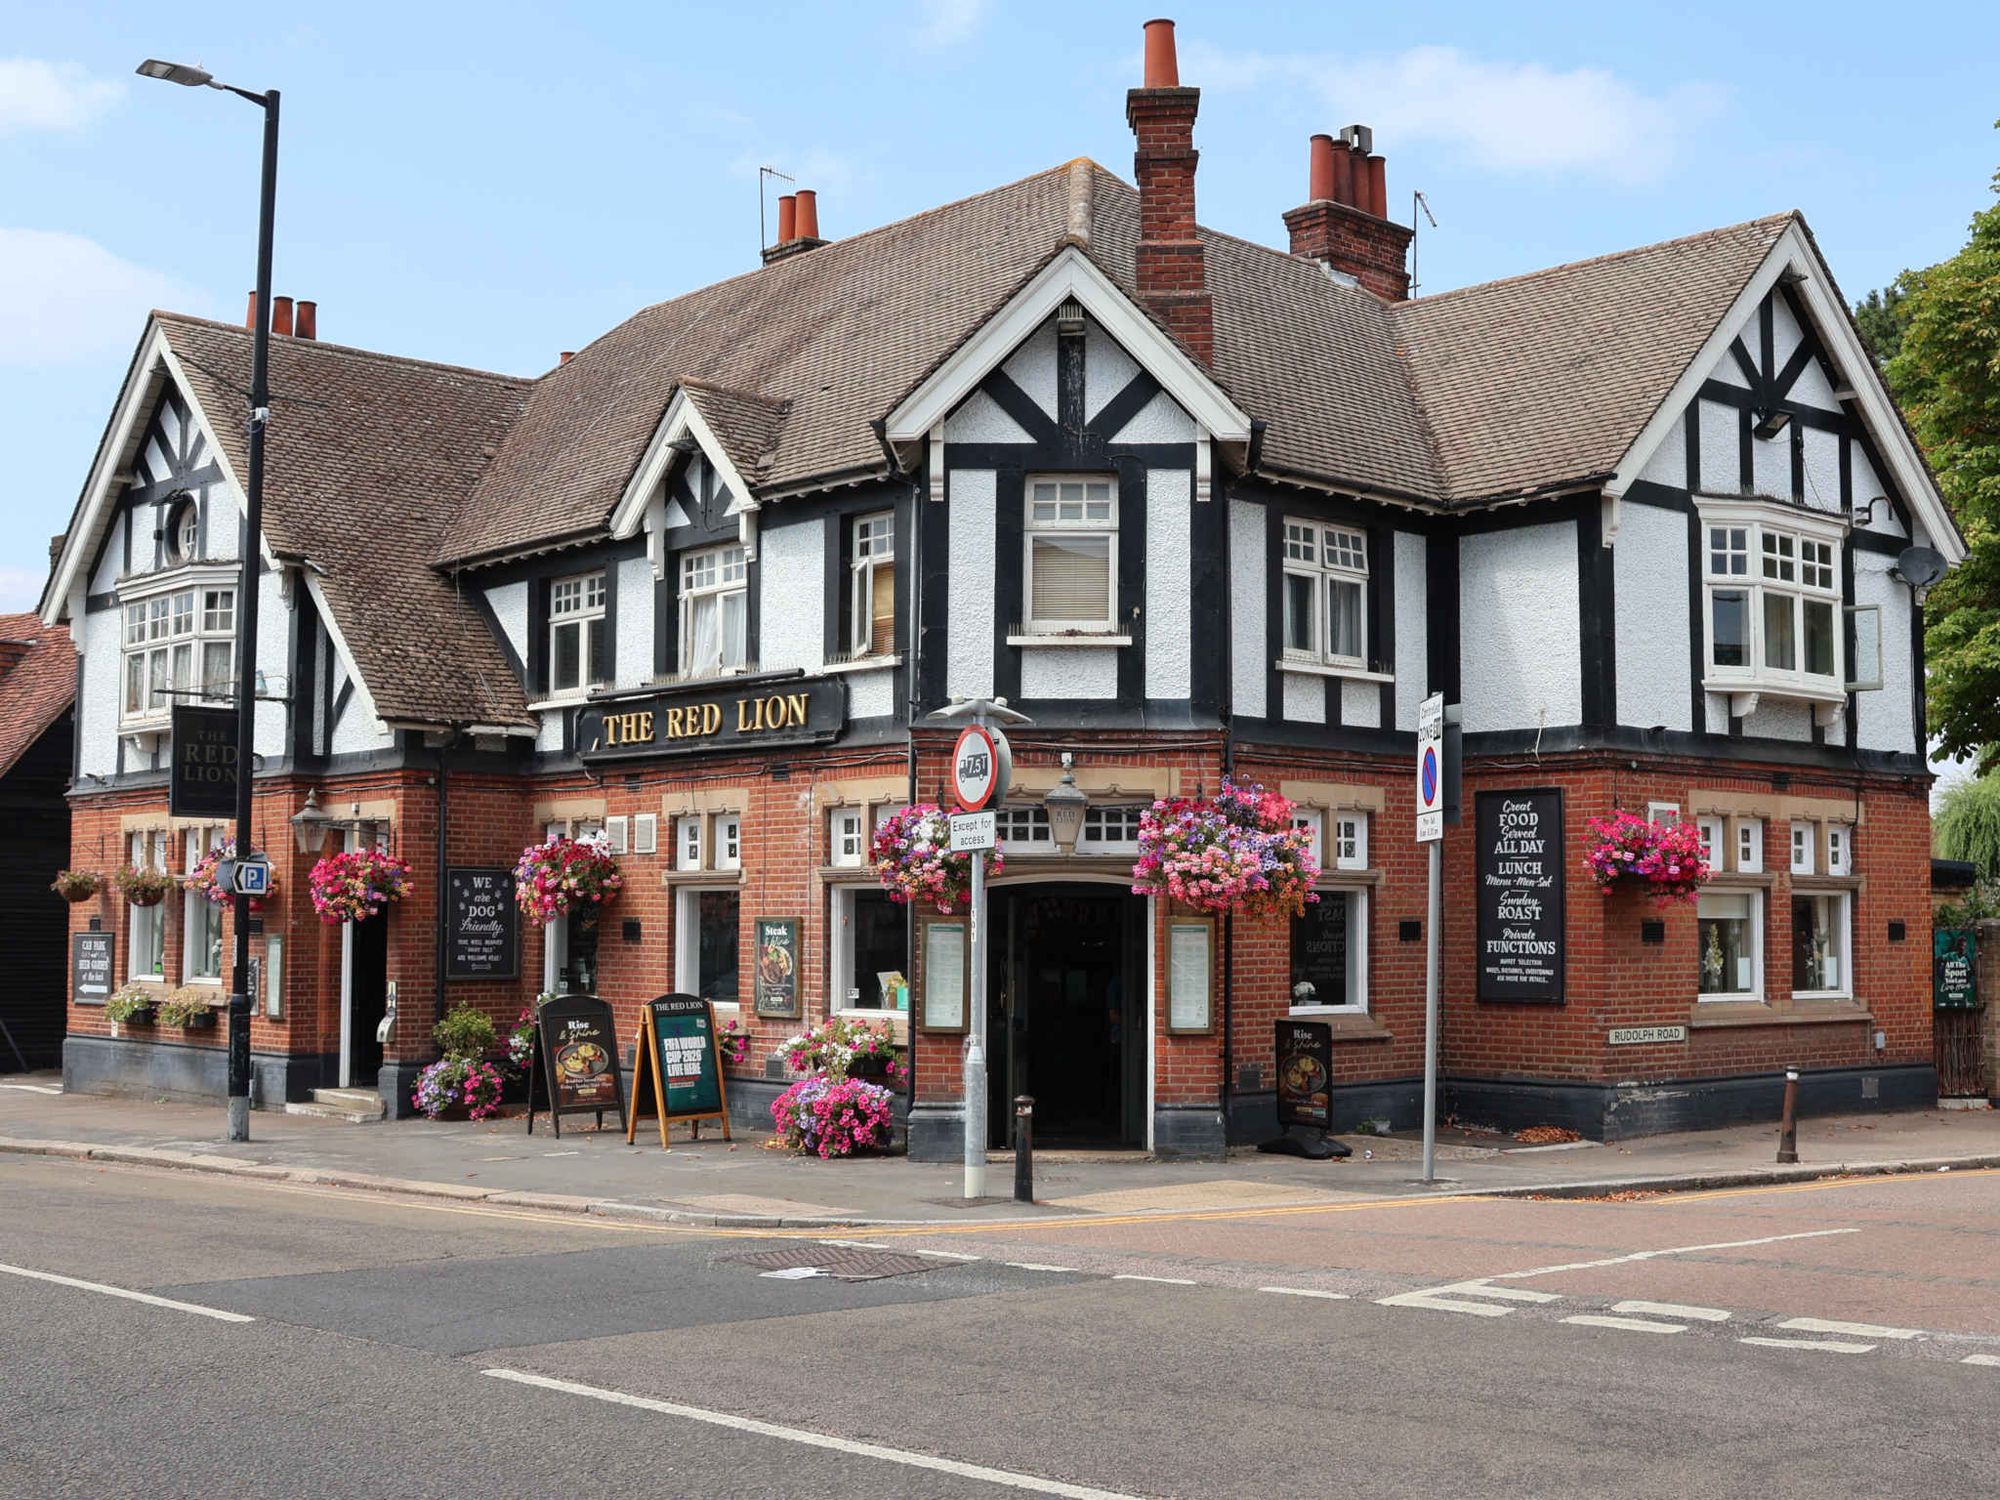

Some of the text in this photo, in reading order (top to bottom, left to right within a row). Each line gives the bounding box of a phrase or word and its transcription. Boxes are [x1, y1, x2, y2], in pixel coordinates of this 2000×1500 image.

[602, 693, 809, 746] THE RED LION
[199, 731, 226, 740] THE
[184, 744, 238, 763] RED
[1503, 800, 1533, 814] Great
[953, 817, 992, 833] Except for
[1499, 813, 1539, 827] FOOD
[1501, 826, 1537, 840] Served
[960, 835, 985, 846] access
[1494, 840, 1546, 854] ALL DAY
[1498, 862, 1542, 875] LUNCH
[248, 868, 258, 888] P
[473, 877, 492, 889] WE
[474, 892, 491, 902] are
[1500, 891, 1541, 909] Sunday
[468, 905, 495, 917] DOG
[1498, 906, 1542, 920] ROAST
[765, 925, 788, 936] Steak
[1503, 928, 1536, 940] Private
[1486, 940, 1556, 955] FUNCTIONS
[1945, 969, 1967, 978] Sport
[655, 1001, 703, 1011] THE RED LION
[568, 1020, 590, 1029] Rise
[569, 1029, 600, 1040] Shine
[1294, 1029, 1312, 1039] Rise
[1614, 1028, 1680, 1042] RUDOLPH ROAD
[680, 1036, 706, 1050] WORLD
[666, 1050, 681, 1064] CUP
[667, 1062, 702, 1077] LIVE HERE
